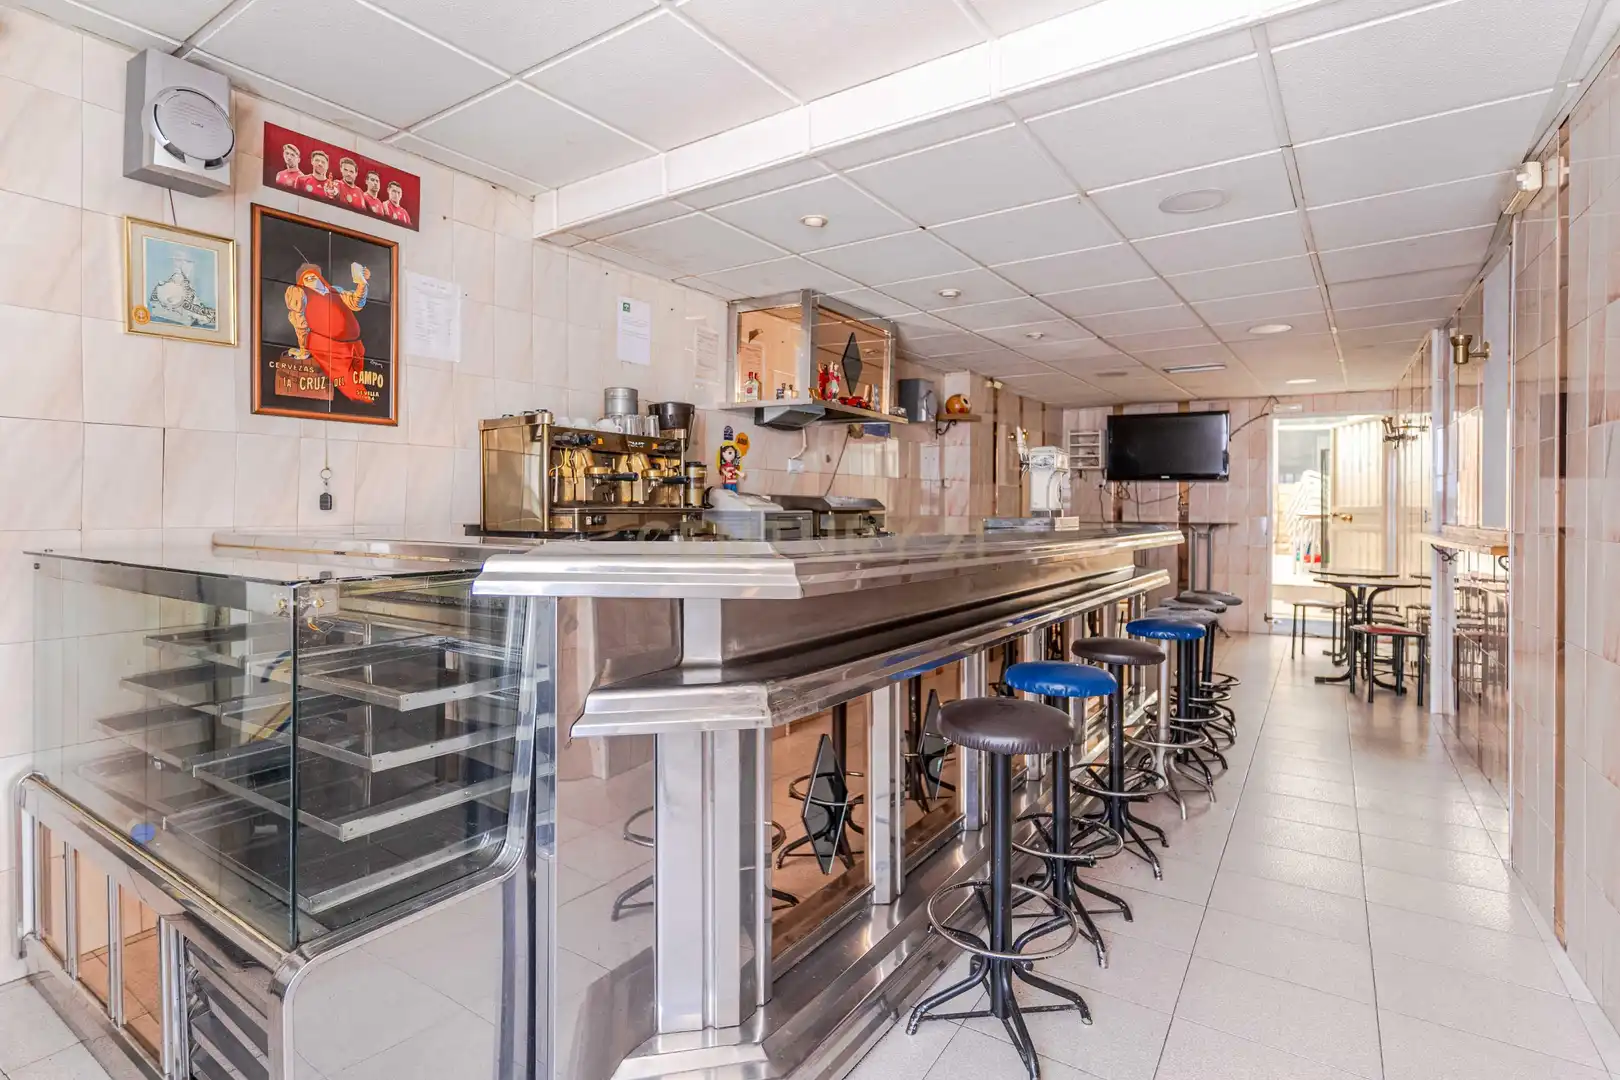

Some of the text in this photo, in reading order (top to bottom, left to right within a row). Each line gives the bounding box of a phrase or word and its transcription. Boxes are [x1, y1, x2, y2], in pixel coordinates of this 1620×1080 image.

[269, 360, 314, 372] CERVEZAS
[299, 376, 326, 390] CRUZ
[333, 377, 345, 387] DEL
[352, 370, 384, 388] CAMPO
